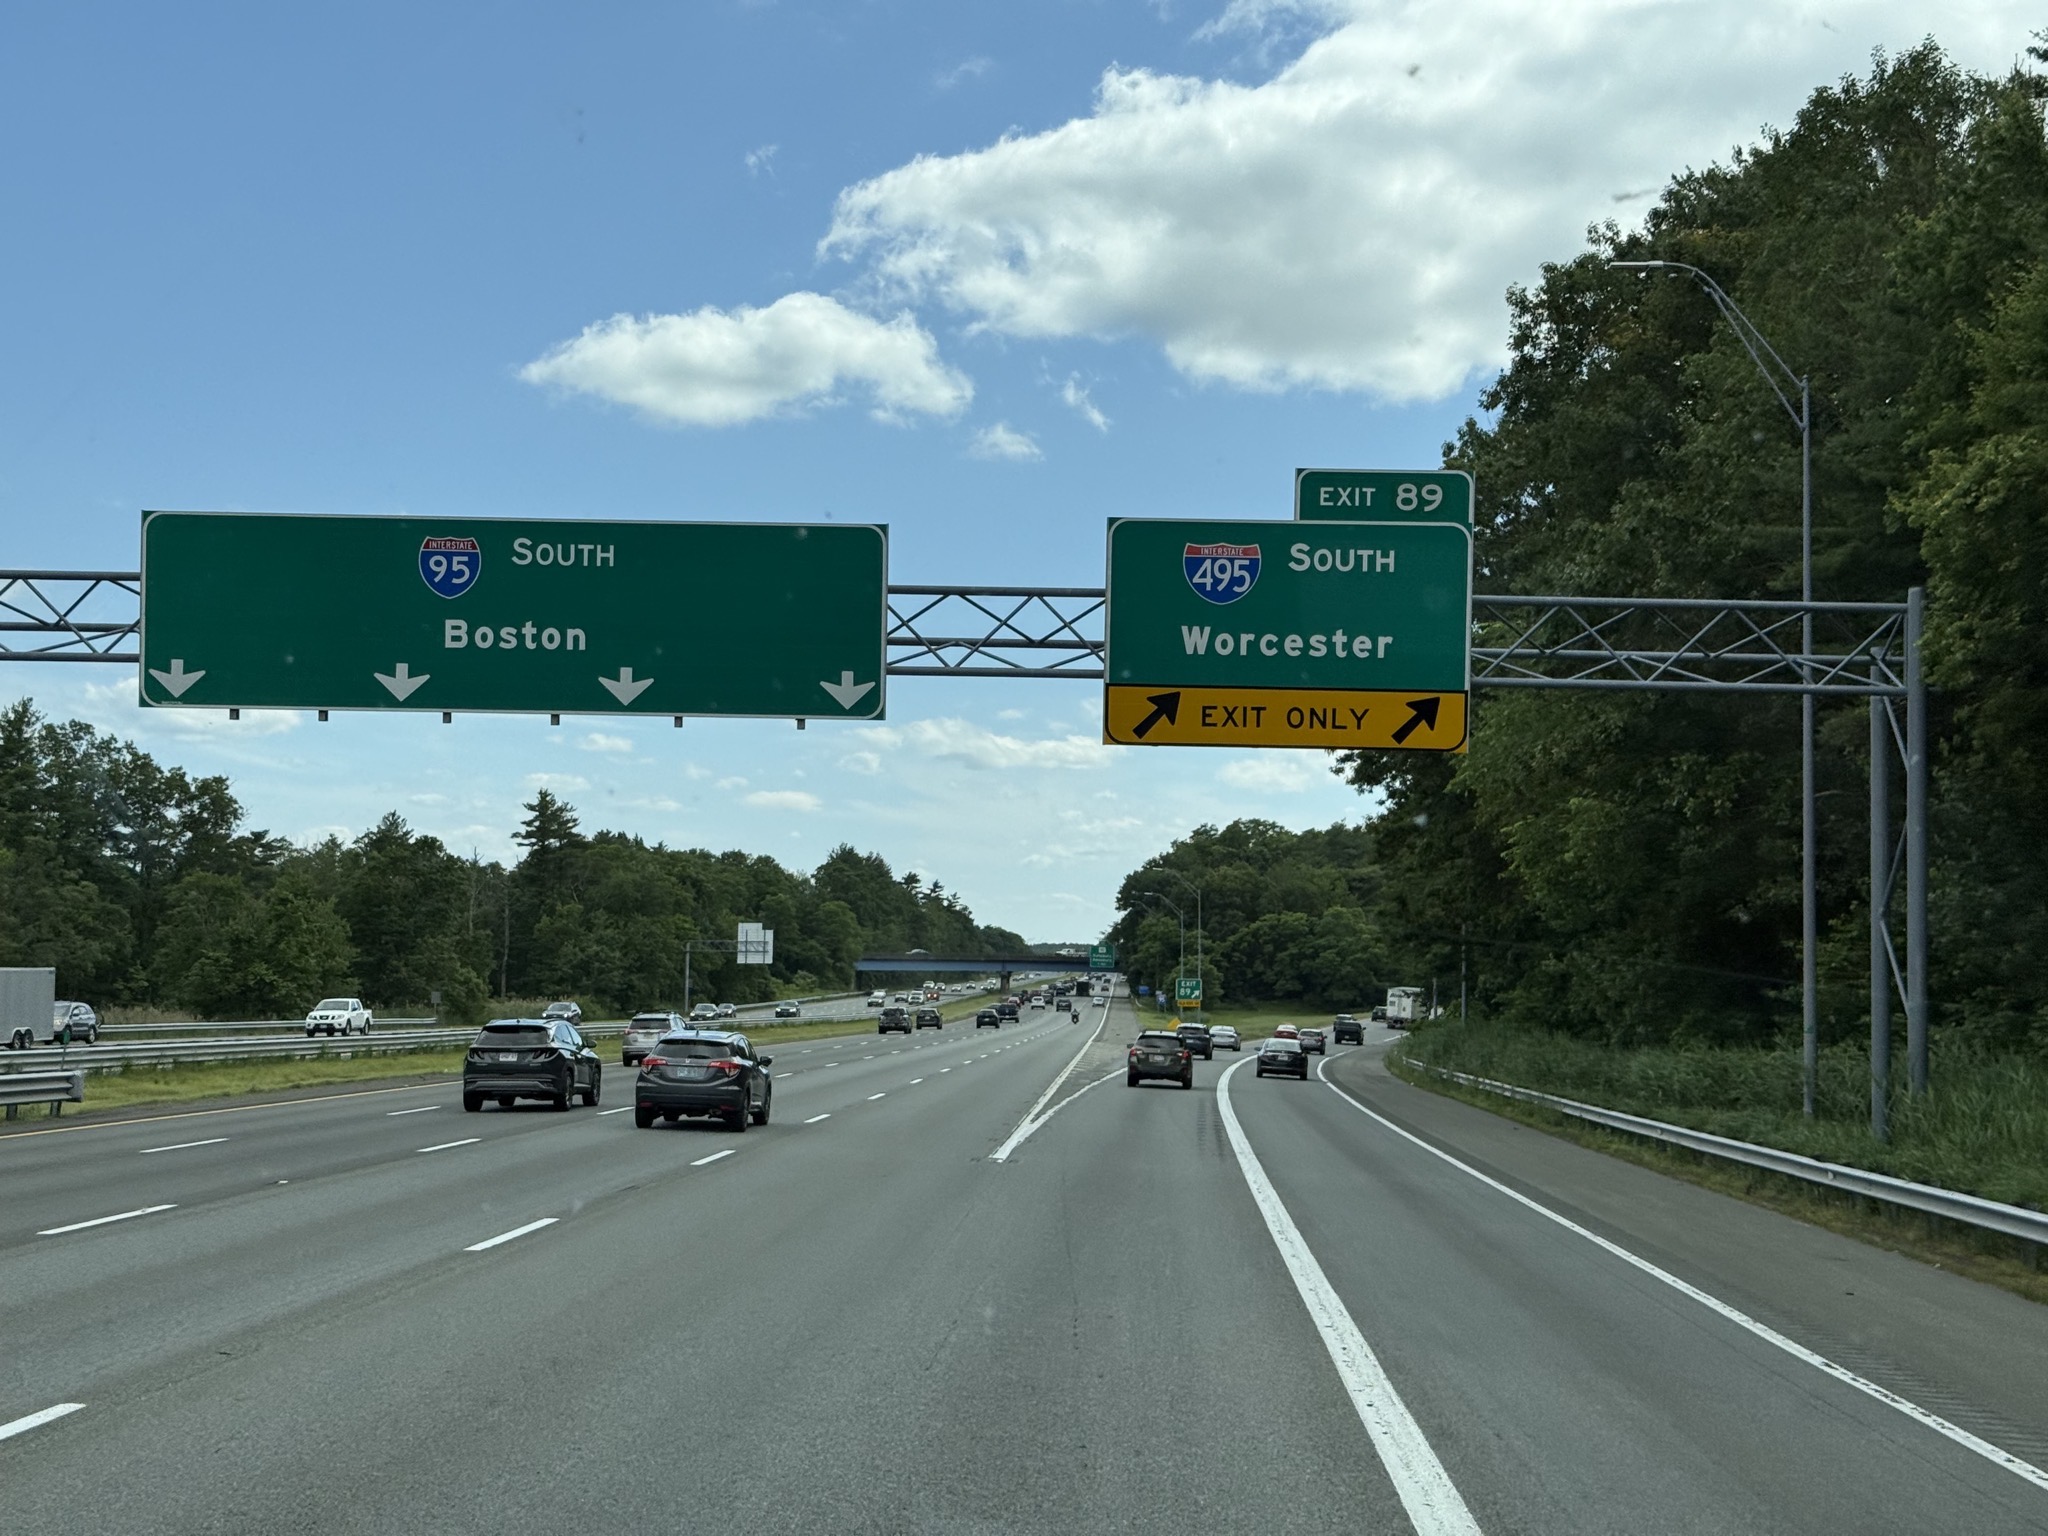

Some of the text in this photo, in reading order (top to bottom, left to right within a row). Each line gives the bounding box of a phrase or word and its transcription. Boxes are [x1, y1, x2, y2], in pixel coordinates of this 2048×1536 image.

[1319, 483, 1443, 512] EXIT 89
[429, 540, 473, 550] INTERSTATE
[511, 537, 615, 567] SOUTH
[1200, 547, 1244, 556] INTERSTATE
[1288, 542, 1395, 573] SOUTH
[428, 555, 470, 584] 95
[1192, 558, 1251, 593] 495
[444, 619, 586, 651] Boston
[1181, 625, 1394, 659] Worcester
[1201, 705, 1370, 730] EXIT ONLY
[1179, 987, 1191, 996] 89
